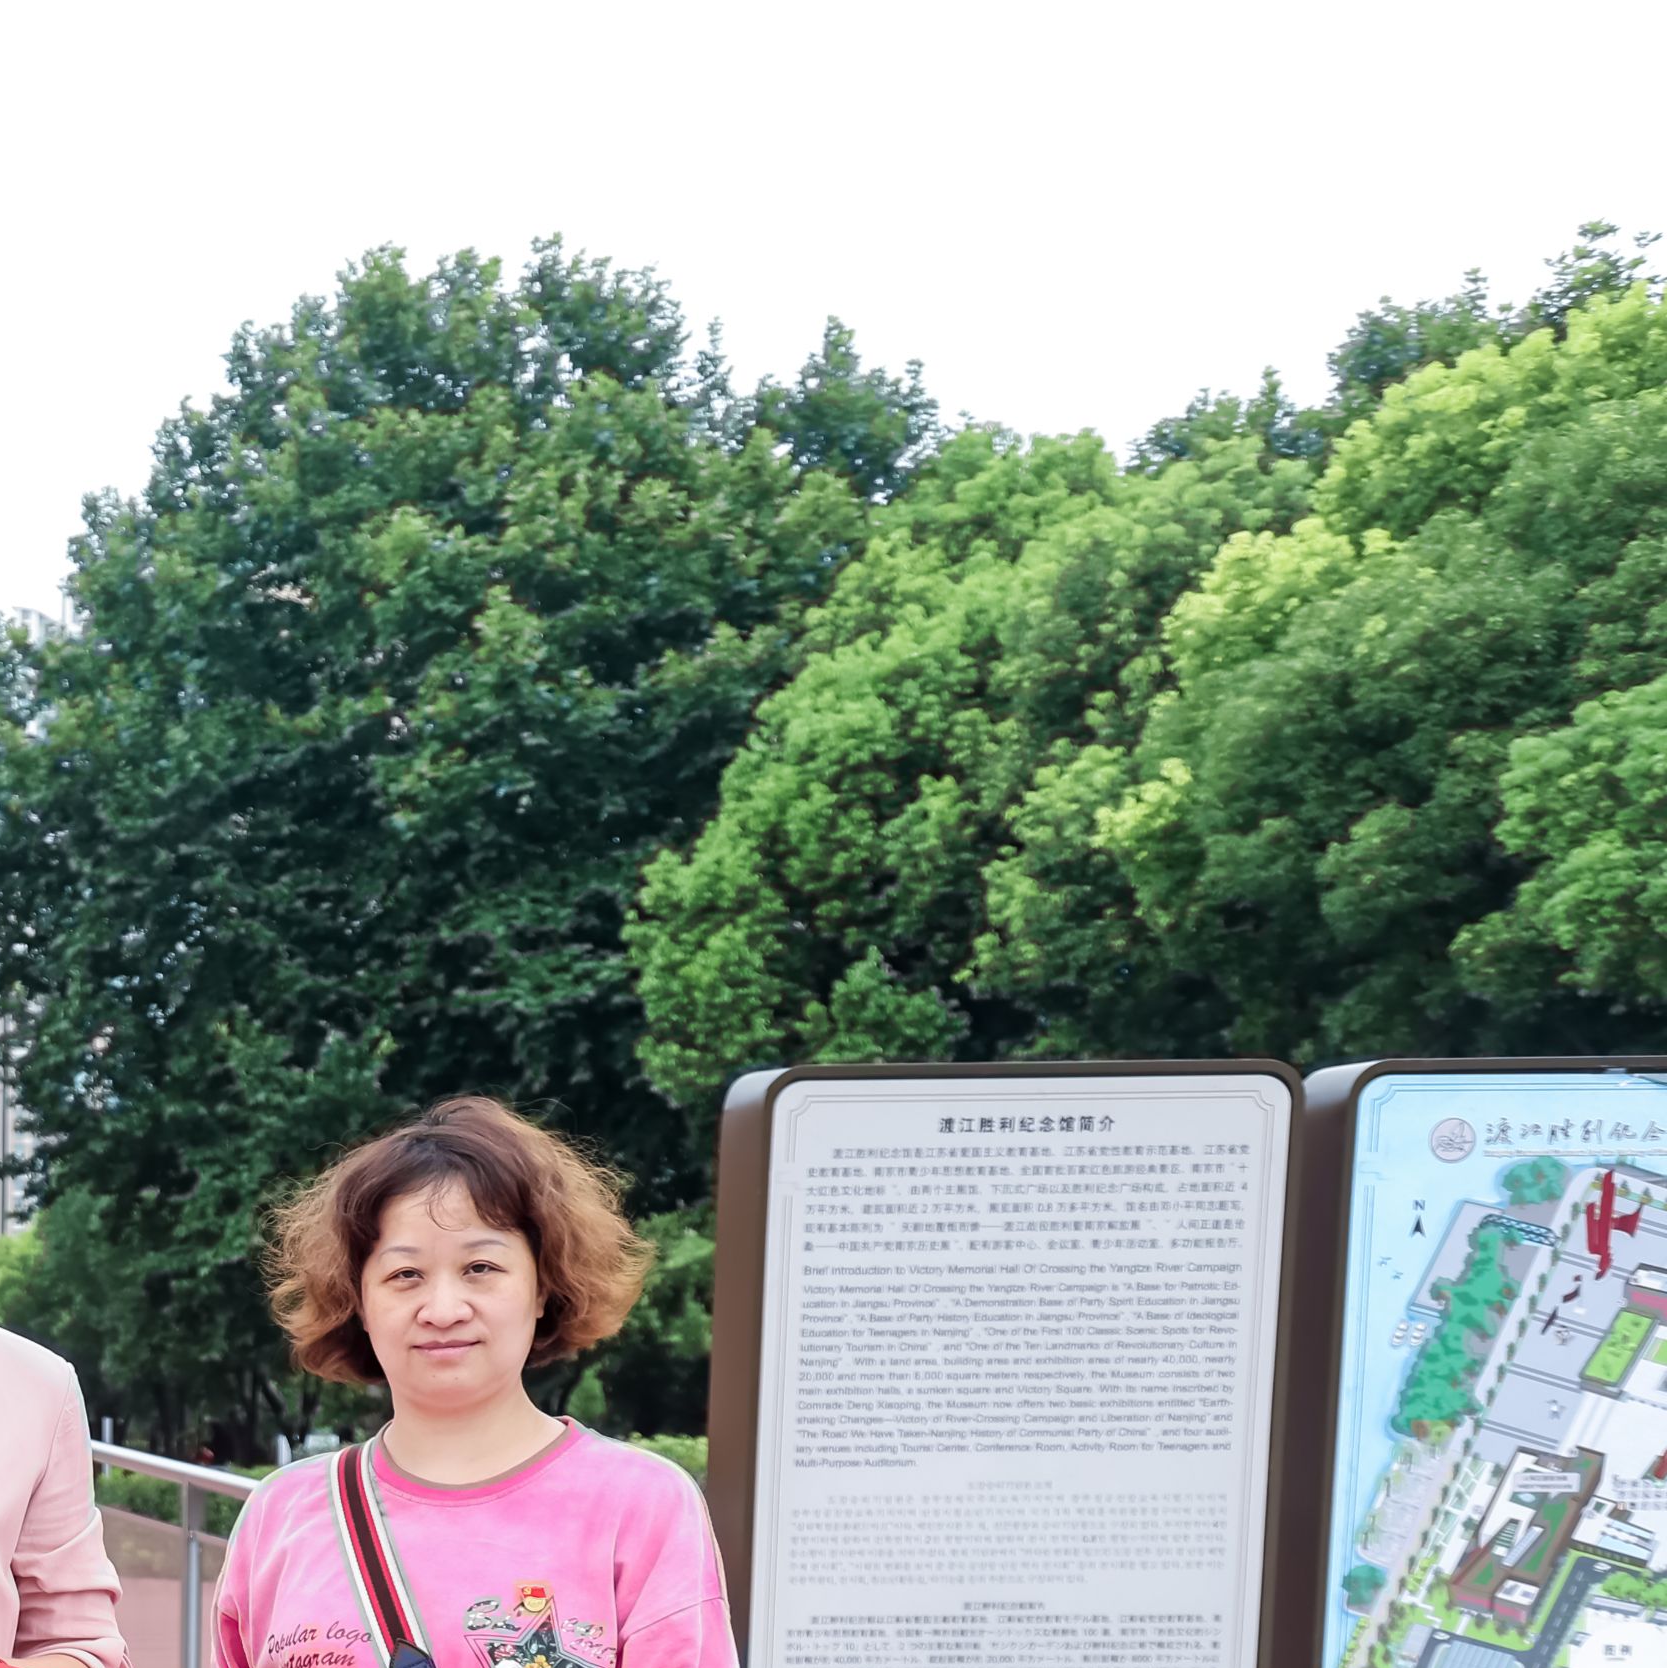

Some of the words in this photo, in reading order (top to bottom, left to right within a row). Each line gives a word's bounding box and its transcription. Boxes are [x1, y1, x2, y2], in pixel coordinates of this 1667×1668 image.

[939, 1115, 1115, 1133] 渡江胜利纪念馆简介
[1412, 1199, 1425, 1210] N
[326, 1620, 373, 1648] logo
